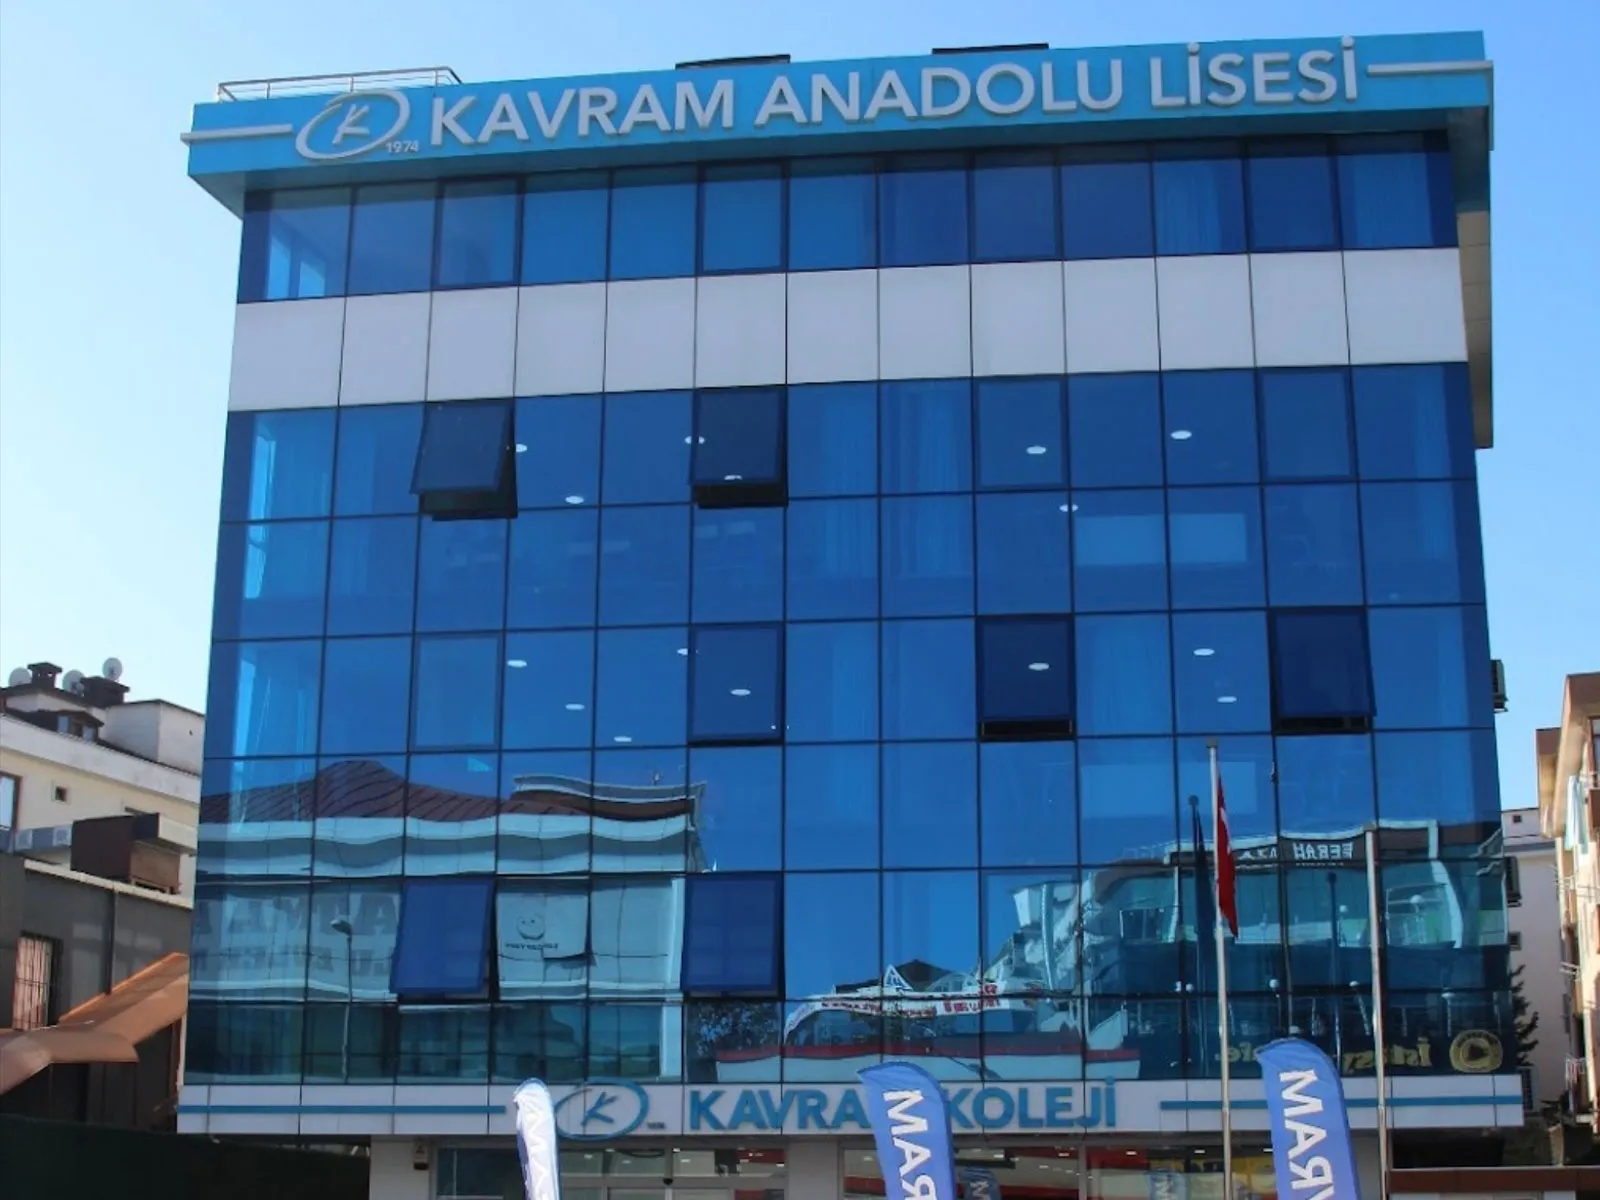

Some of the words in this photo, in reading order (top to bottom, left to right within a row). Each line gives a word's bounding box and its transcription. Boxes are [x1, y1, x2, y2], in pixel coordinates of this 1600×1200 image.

[431, 80, 734, 146] KAVRAM
[755, 60, 1122, 126] ANADOLU
[1151, 36, 1357, 107] LİSESİ
[386, 139, 420, 154] 1974
[689, 1091, 871, 1130] KAVRA
